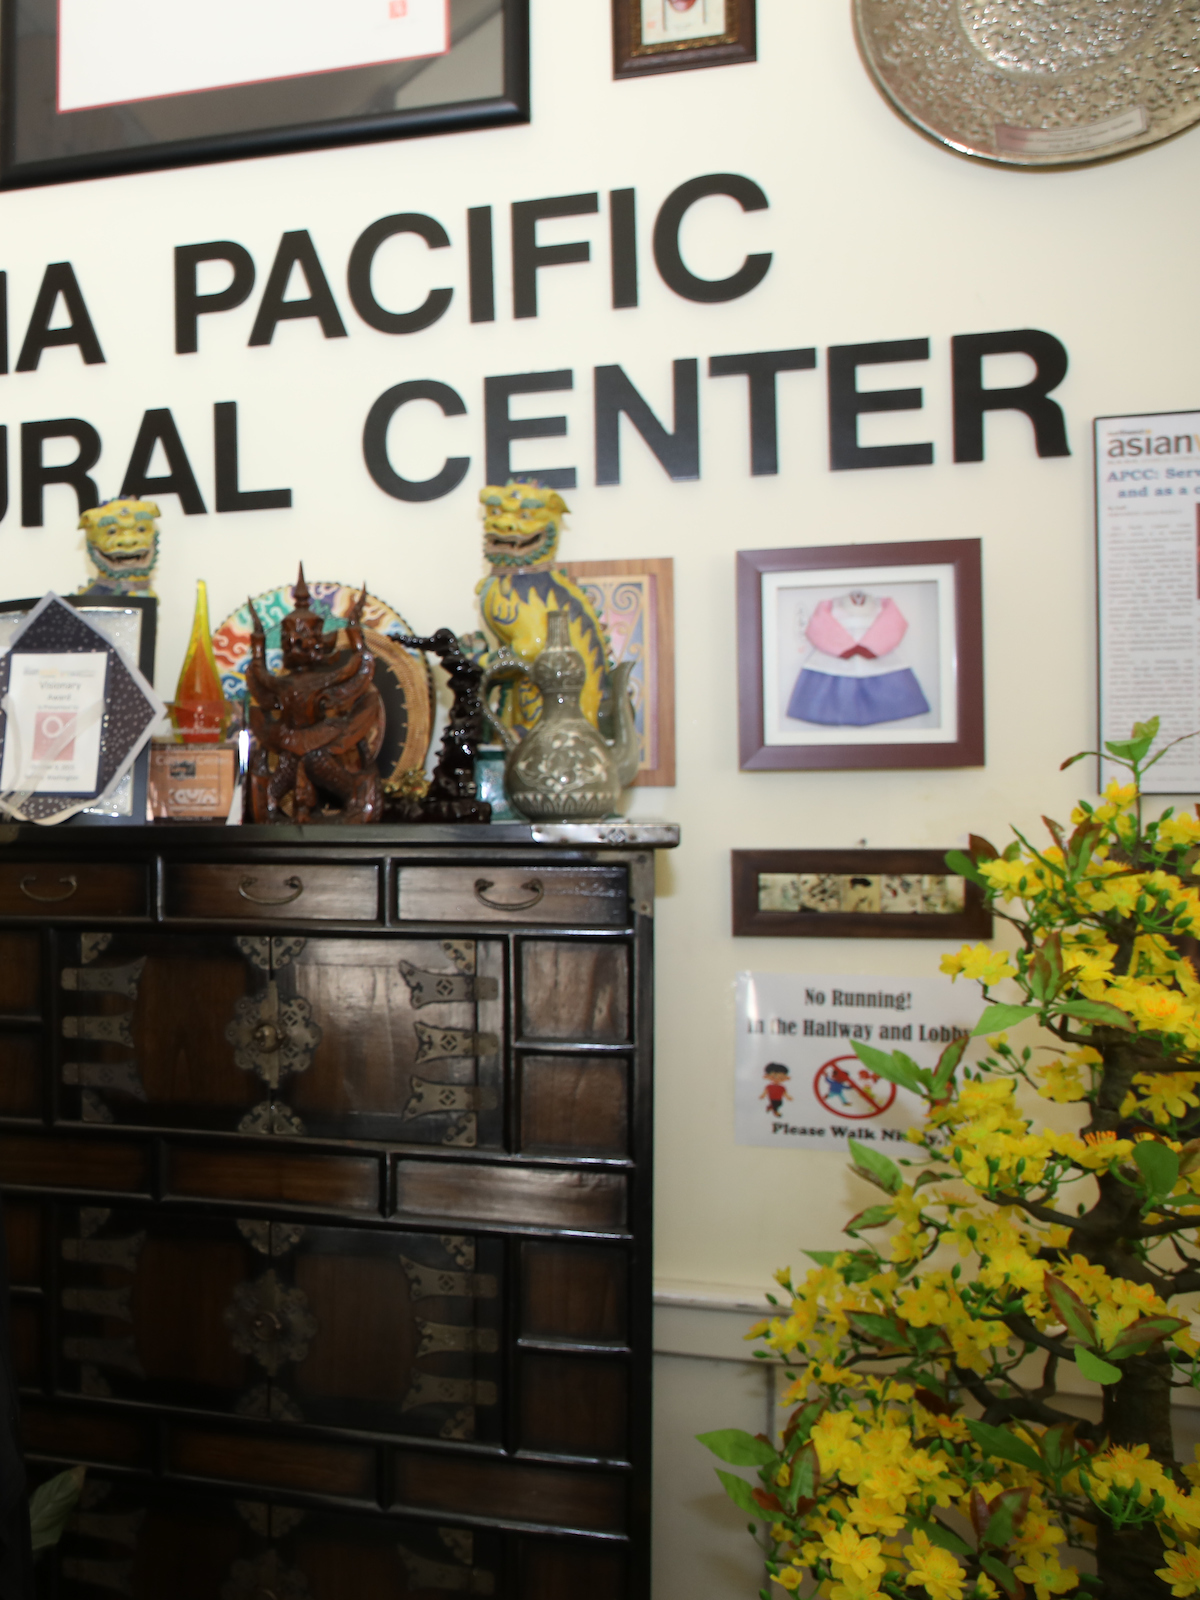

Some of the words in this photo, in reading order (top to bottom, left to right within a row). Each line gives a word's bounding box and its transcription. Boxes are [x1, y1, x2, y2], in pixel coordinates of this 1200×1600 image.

[174, 173, 773, 354] PACIFIC
[362, 329, 1071, 502] CENTER
[1107, 468, 1159, 482] APCC:
[1118, 486, 1149, 499] and
[1154, 487, 1173, 497] as
[1179, 487, 1188, 496] a
[804, 988, 826, 1006] No
[831, 989, 912, 1011] Running!
[803, 1019, 873, 1042] Hallway
[879, 1024, 913, 1041] and
[772, 1122, 826, 1137] Please
[830, 1125, 875, 1141] Walk
